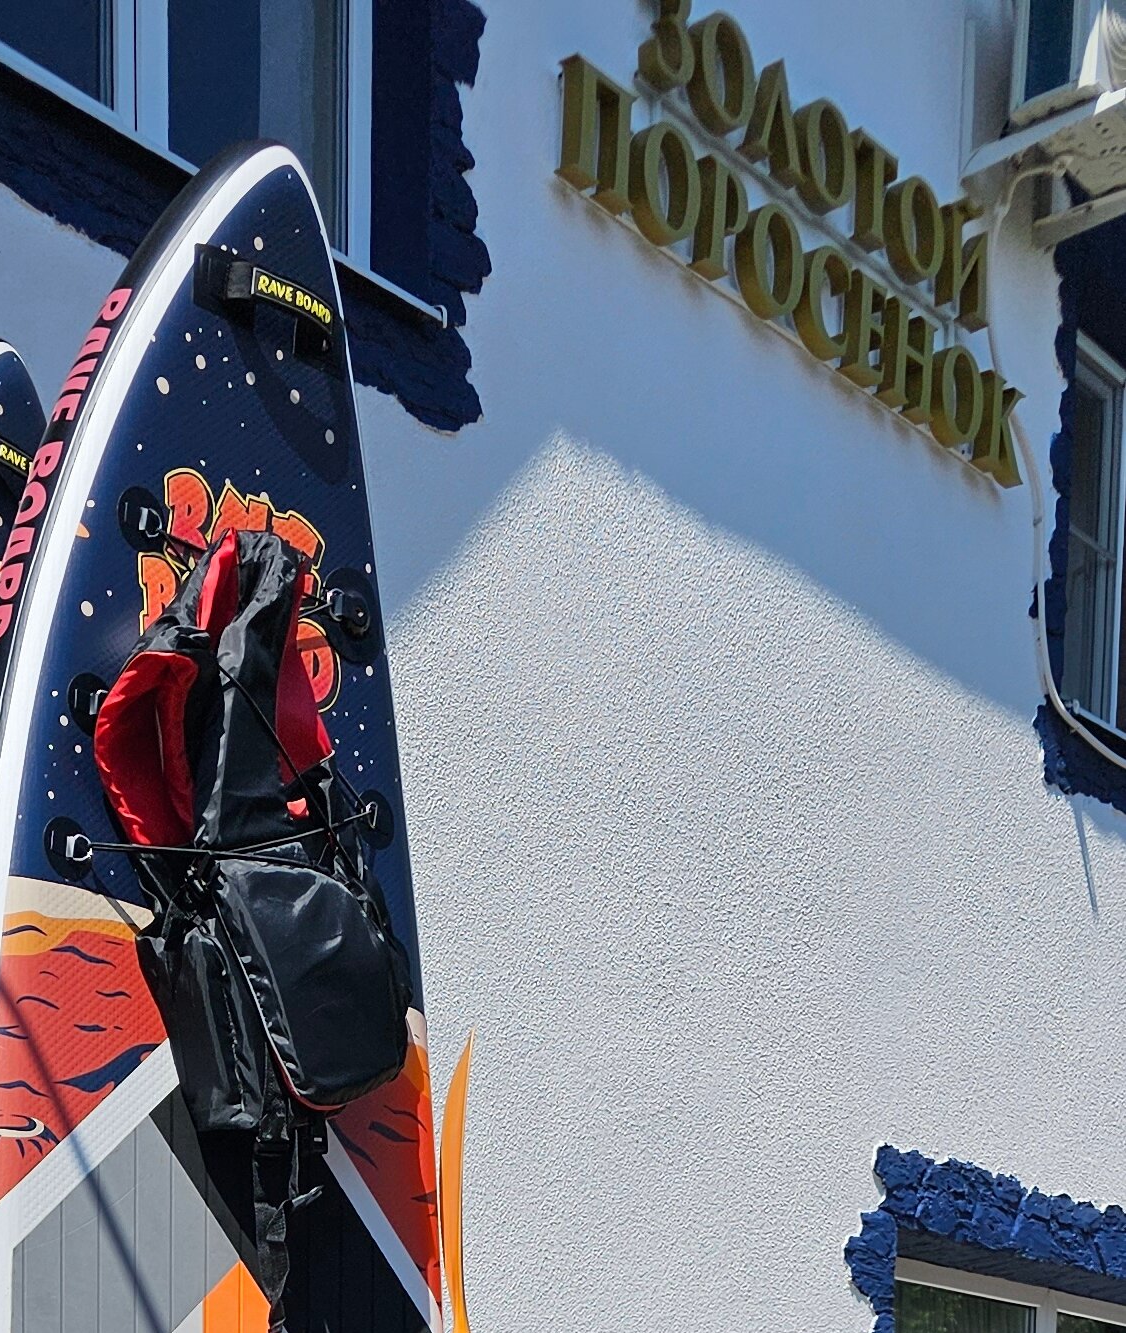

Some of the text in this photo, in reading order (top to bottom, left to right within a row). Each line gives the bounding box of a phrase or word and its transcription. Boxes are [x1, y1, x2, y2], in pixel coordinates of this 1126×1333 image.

[638, 0, 990, 333] ЗОЛОТОЙ
[258, 274, 331, 324] RAVE BOARD
[556, 52, 1026, 489] ПОРОСЕНОК
[51, 288, 132, 423] RAVE
[0, 444, 28, 470] RAVE
